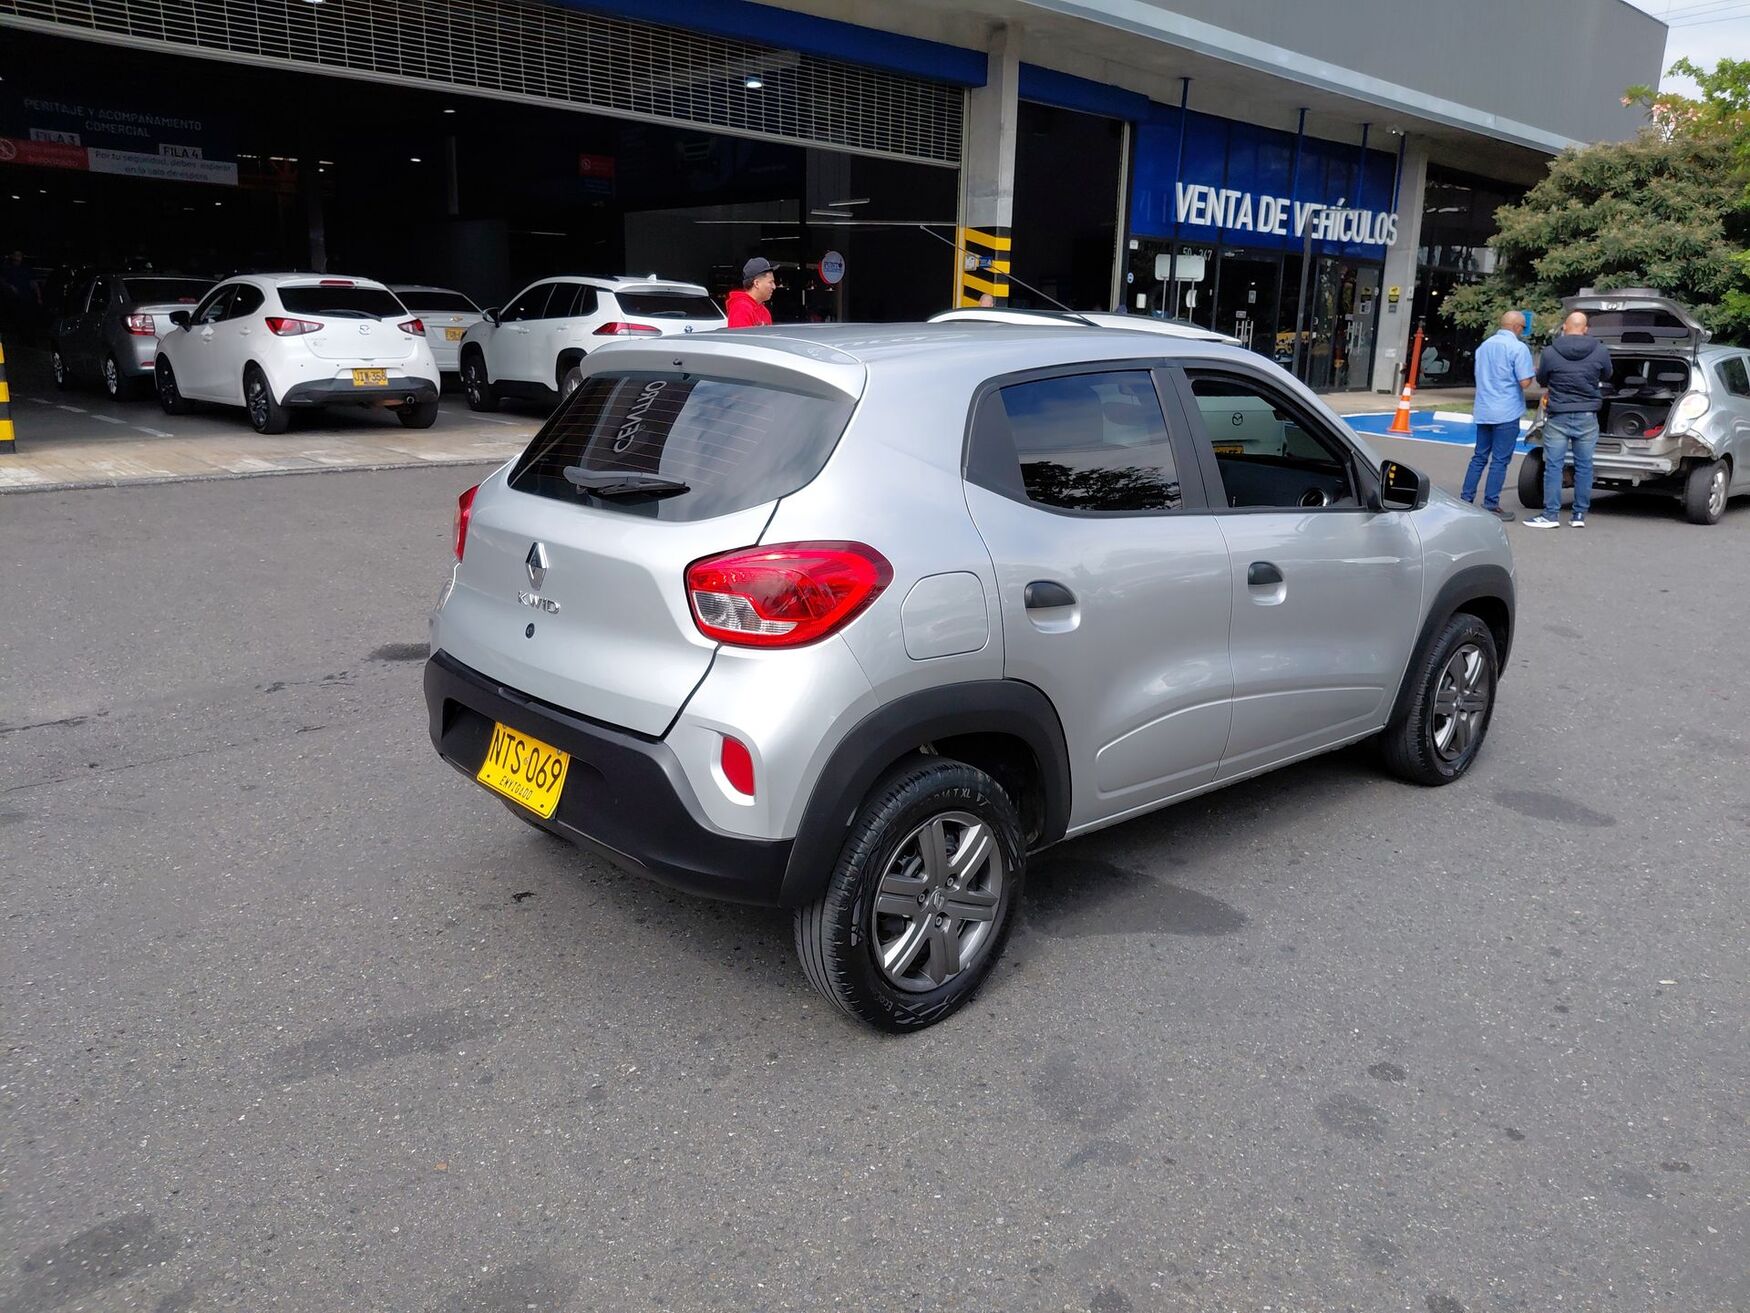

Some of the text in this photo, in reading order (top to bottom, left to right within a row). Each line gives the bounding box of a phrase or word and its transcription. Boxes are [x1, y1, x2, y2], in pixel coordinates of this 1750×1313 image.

[85, 121, 151, 137] COMERCIAL
[88, 108, 95, 117] Y
[98, 109, 202, 131] ACOMPAÑAMIENTO
[164, 146, 188, 158] FILA
[1176, 182, 1399, 246] VENTA DE VEHÍCULOS
[518, 590, 560, 614] KWID
